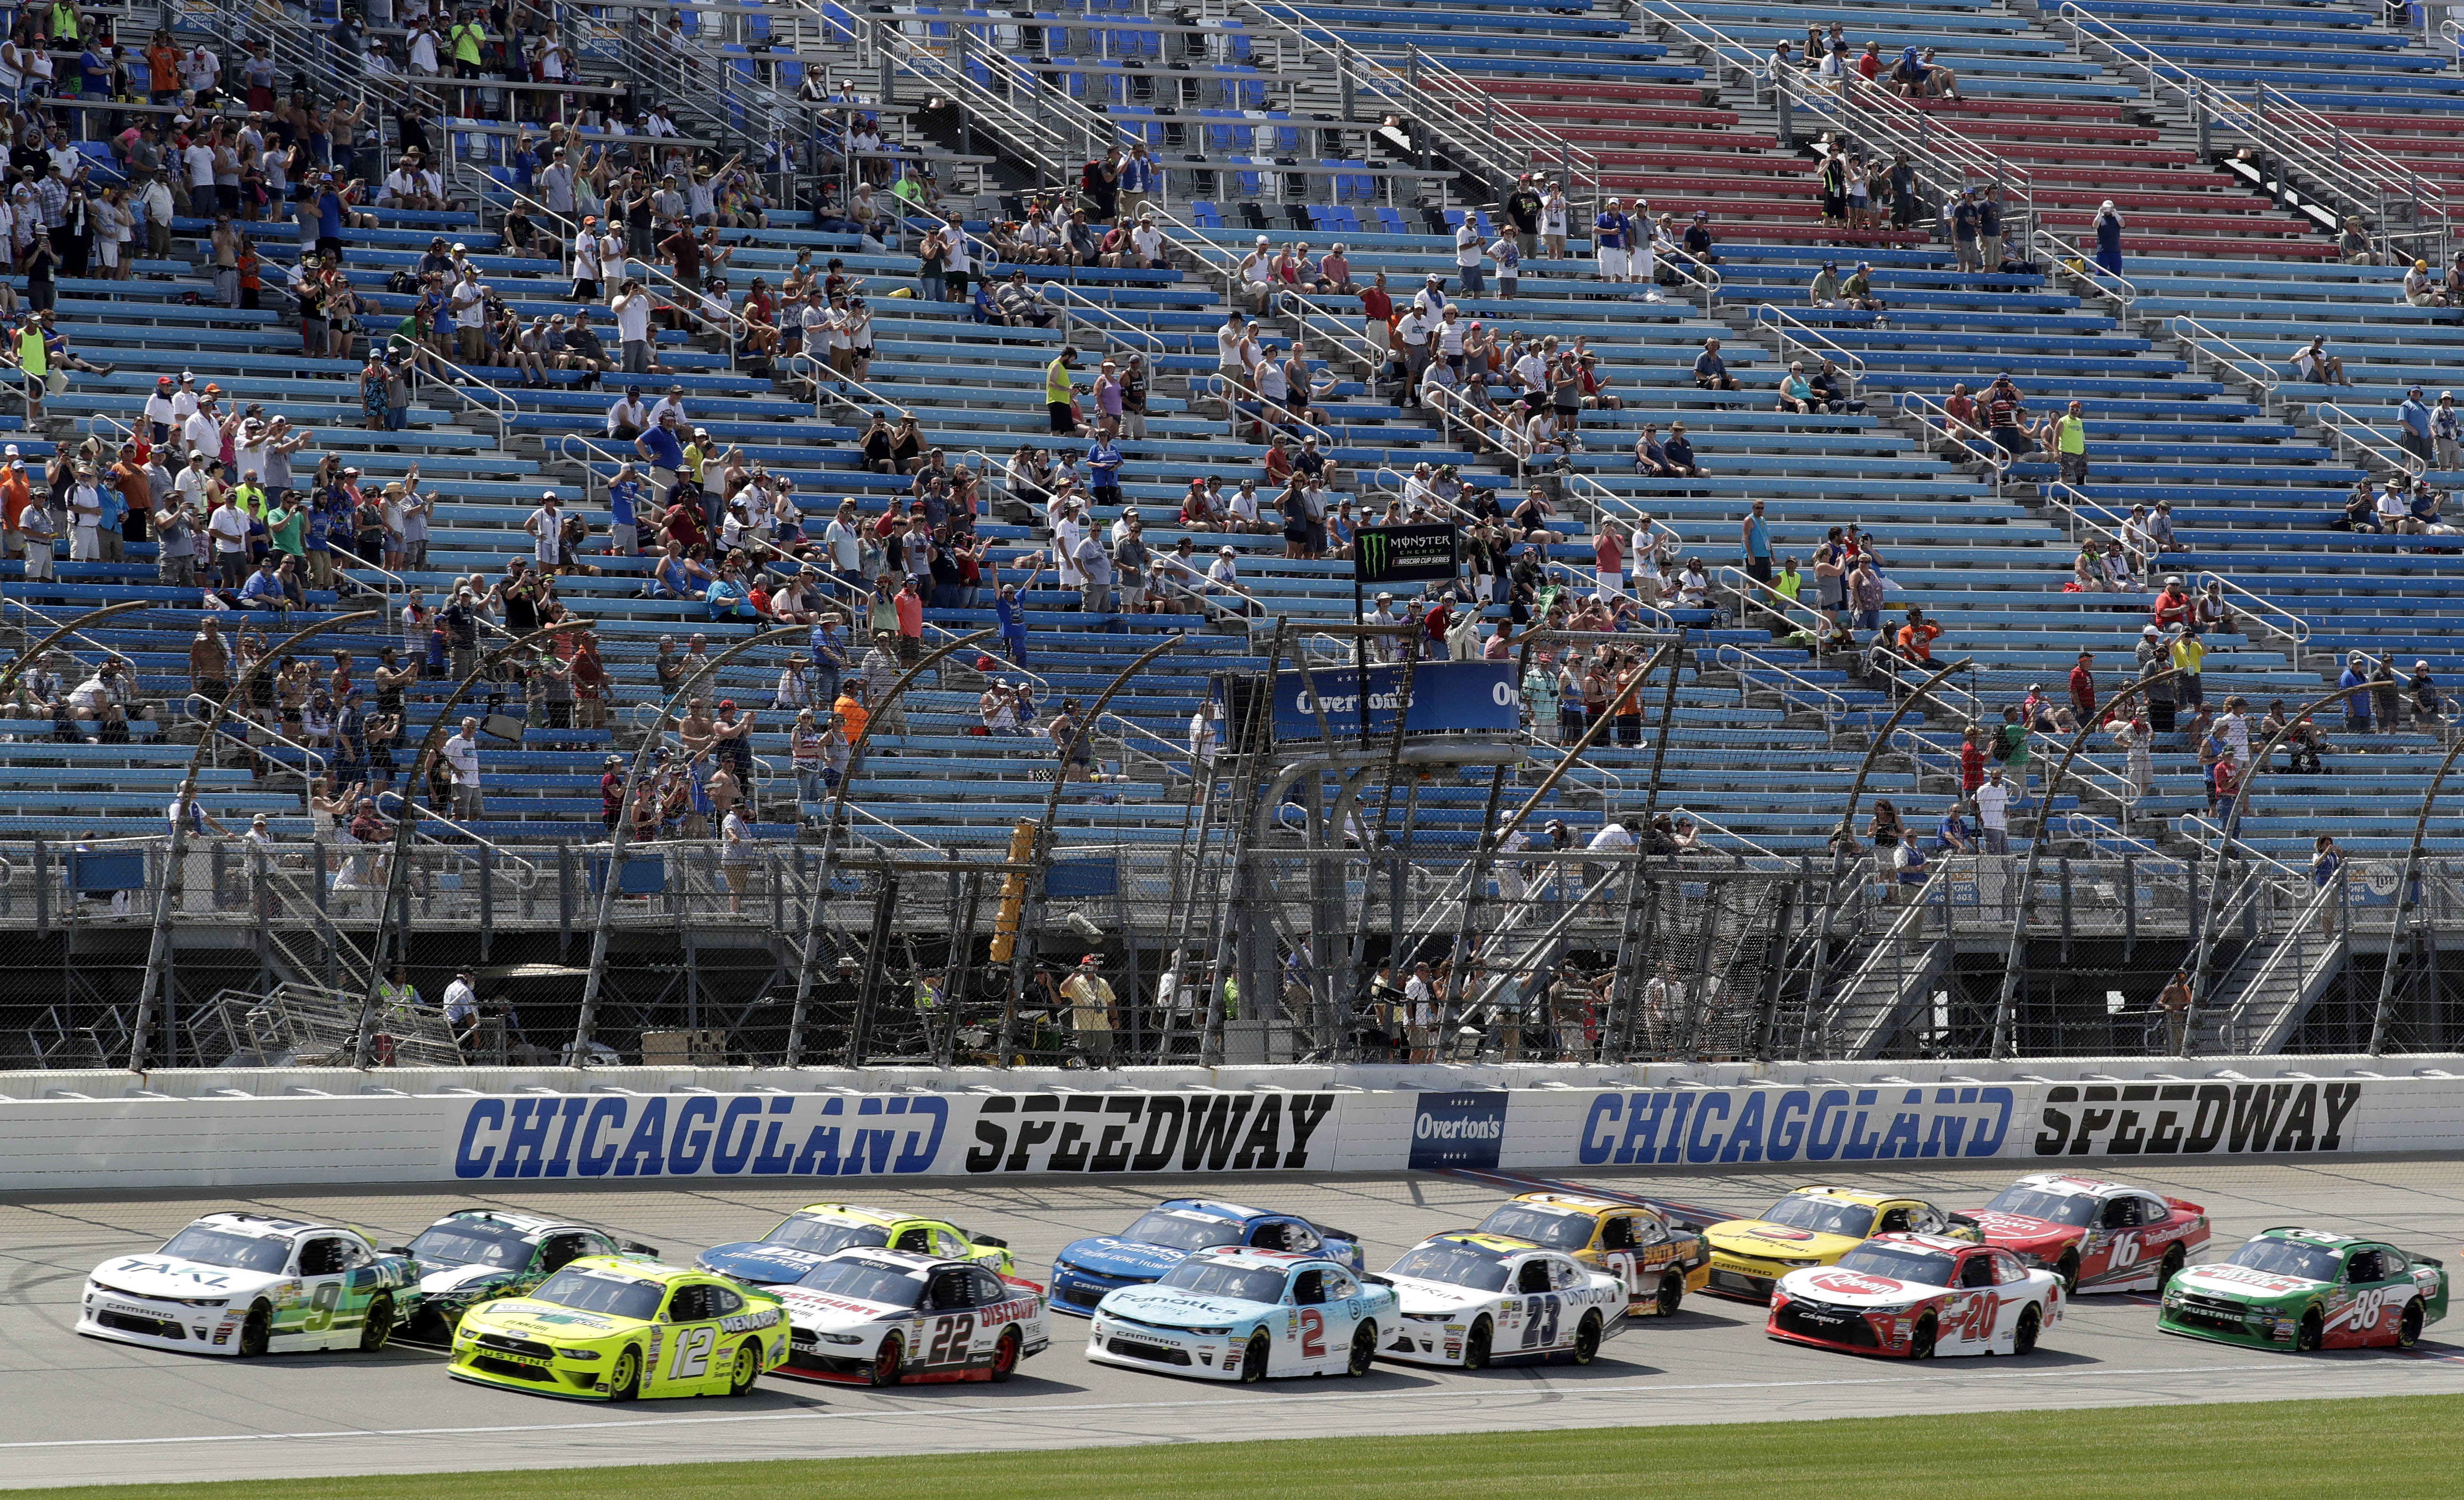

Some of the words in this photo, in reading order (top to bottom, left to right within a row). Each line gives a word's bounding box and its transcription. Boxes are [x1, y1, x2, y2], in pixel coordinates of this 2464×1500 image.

[1390, 535, 1451, 548] MONSTER
[1417, 1113, 1500, 1139] Overton's
[1579, 1087, 2013, 1164] CHICAGOLAND
[2035, 1083, 2361, 1155] SPEEDWAY
[455, 1096, 948, 1178] CHICAGOLAND
[965, 1094, 1335, 1173] SPEEDWAY
[471, 1224, 505, 1234] xfinity
[1972, 1215, 2037, 1231] Down
[1450, 1248, 1481, 1258] xfinity
[2109, 1231, 2140, 1269] 16
[2283, 1240, 2312, 1249] xfinity
[857, 1260, 891, 1270] xfinity
[1109, 1254, 1139, 1264] DONE
[1713, 1262, 1773, 1276] CAMARO
[1810, 1272, 1898, 1294] Rheem
[86, 1294, 94, 1303] 9
[303, 1278, 343, 1333] 9
[766, 1289, 881, 1315] DISCOUNT
[1113, 1293, 1240, 1315] Fanatics
[106, 1302, 174, 1319] CAMARO
[719, 1307, 780, 1335] MENARDS
[979, 1297, 1038, 1327] DISCOUNT
[1799, 1312, 1845, 1324] CAMRY
[1960, 1289, 1998, 1343] 20
[2182, 1305, 2243, 1322] MUSTANG
[2349, 1288, 2384, 1332] 98
[505, 1320, 549, 1331] PENNZOIL
[1096, 1322, 1101, 1331] 2
[1301, 1307, 1327, 1360] 2
[1521, 1296, 1561, 1349] 23
[924, 1314, 974, 1367] 22
[1117, 1331, 1182, 1347] CAMARO
[472, 1347, 553, 1367] MUSTANG
[668, 1326, 715, 1381] 12
